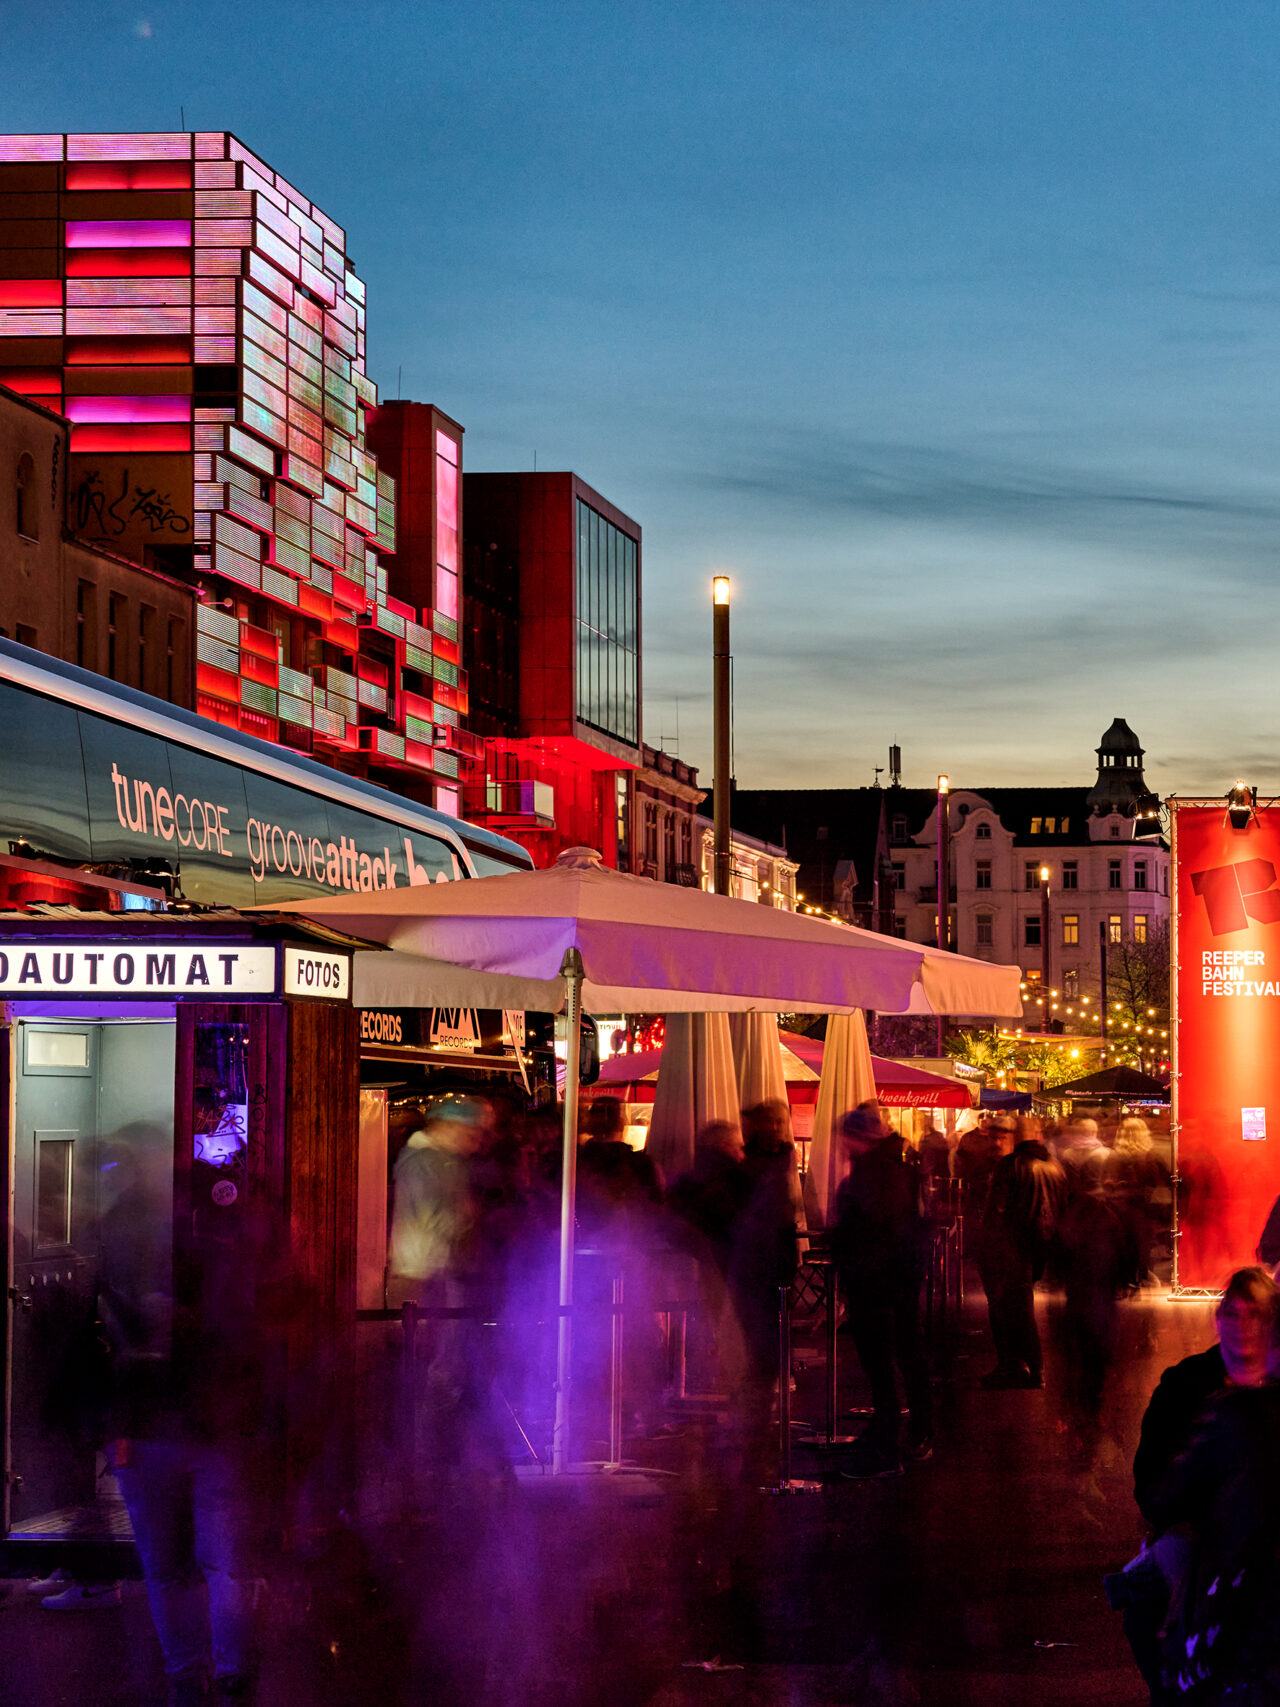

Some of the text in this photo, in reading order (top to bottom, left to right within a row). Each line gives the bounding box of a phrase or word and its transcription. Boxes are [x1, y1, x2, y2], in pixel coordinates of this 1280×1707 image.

[111, 762, 233, 858] tuneCORE
[247, 817, 397, 893] grooveattack
[1202, 950, 1266, 966] REEPER
[296, 958, 341, 990] FOTOS
[1202, 966, 1245, 981] BAHN
[440, 1034, 474, 1050] RECORDS
